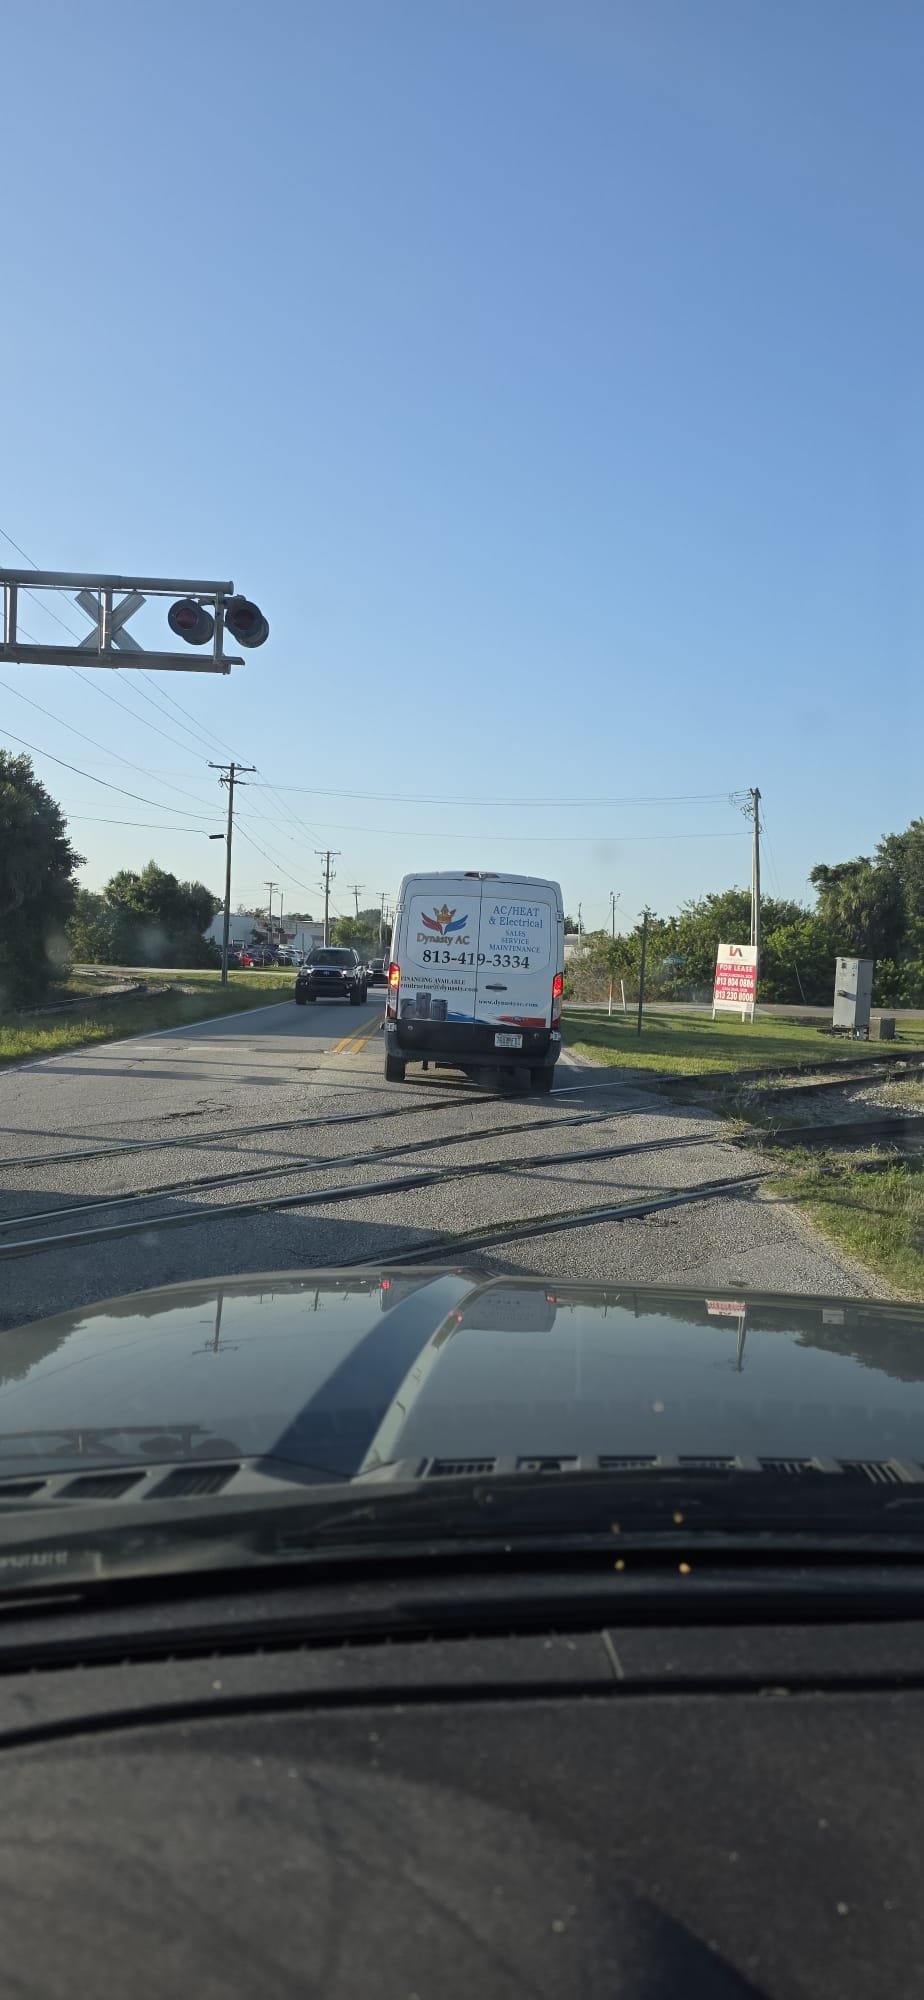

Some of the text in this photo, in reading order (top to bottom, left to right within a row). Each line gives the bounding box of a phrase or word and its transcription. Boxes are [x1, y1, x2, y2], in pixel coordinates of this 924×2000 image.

[493, 905, 539, 916] AC/HEAT
[488, 916, 543, 928] & Electrical
[416, 932, 471, 947] Dynasty AC
[502, 937, 529, 945] SERVICE
[489, 944, 541, 953] MAINTENANCE
[422, 949, 530, 969] 813-419-3334
[400, 975, 466, 985] FINANCING AVAILABLE
